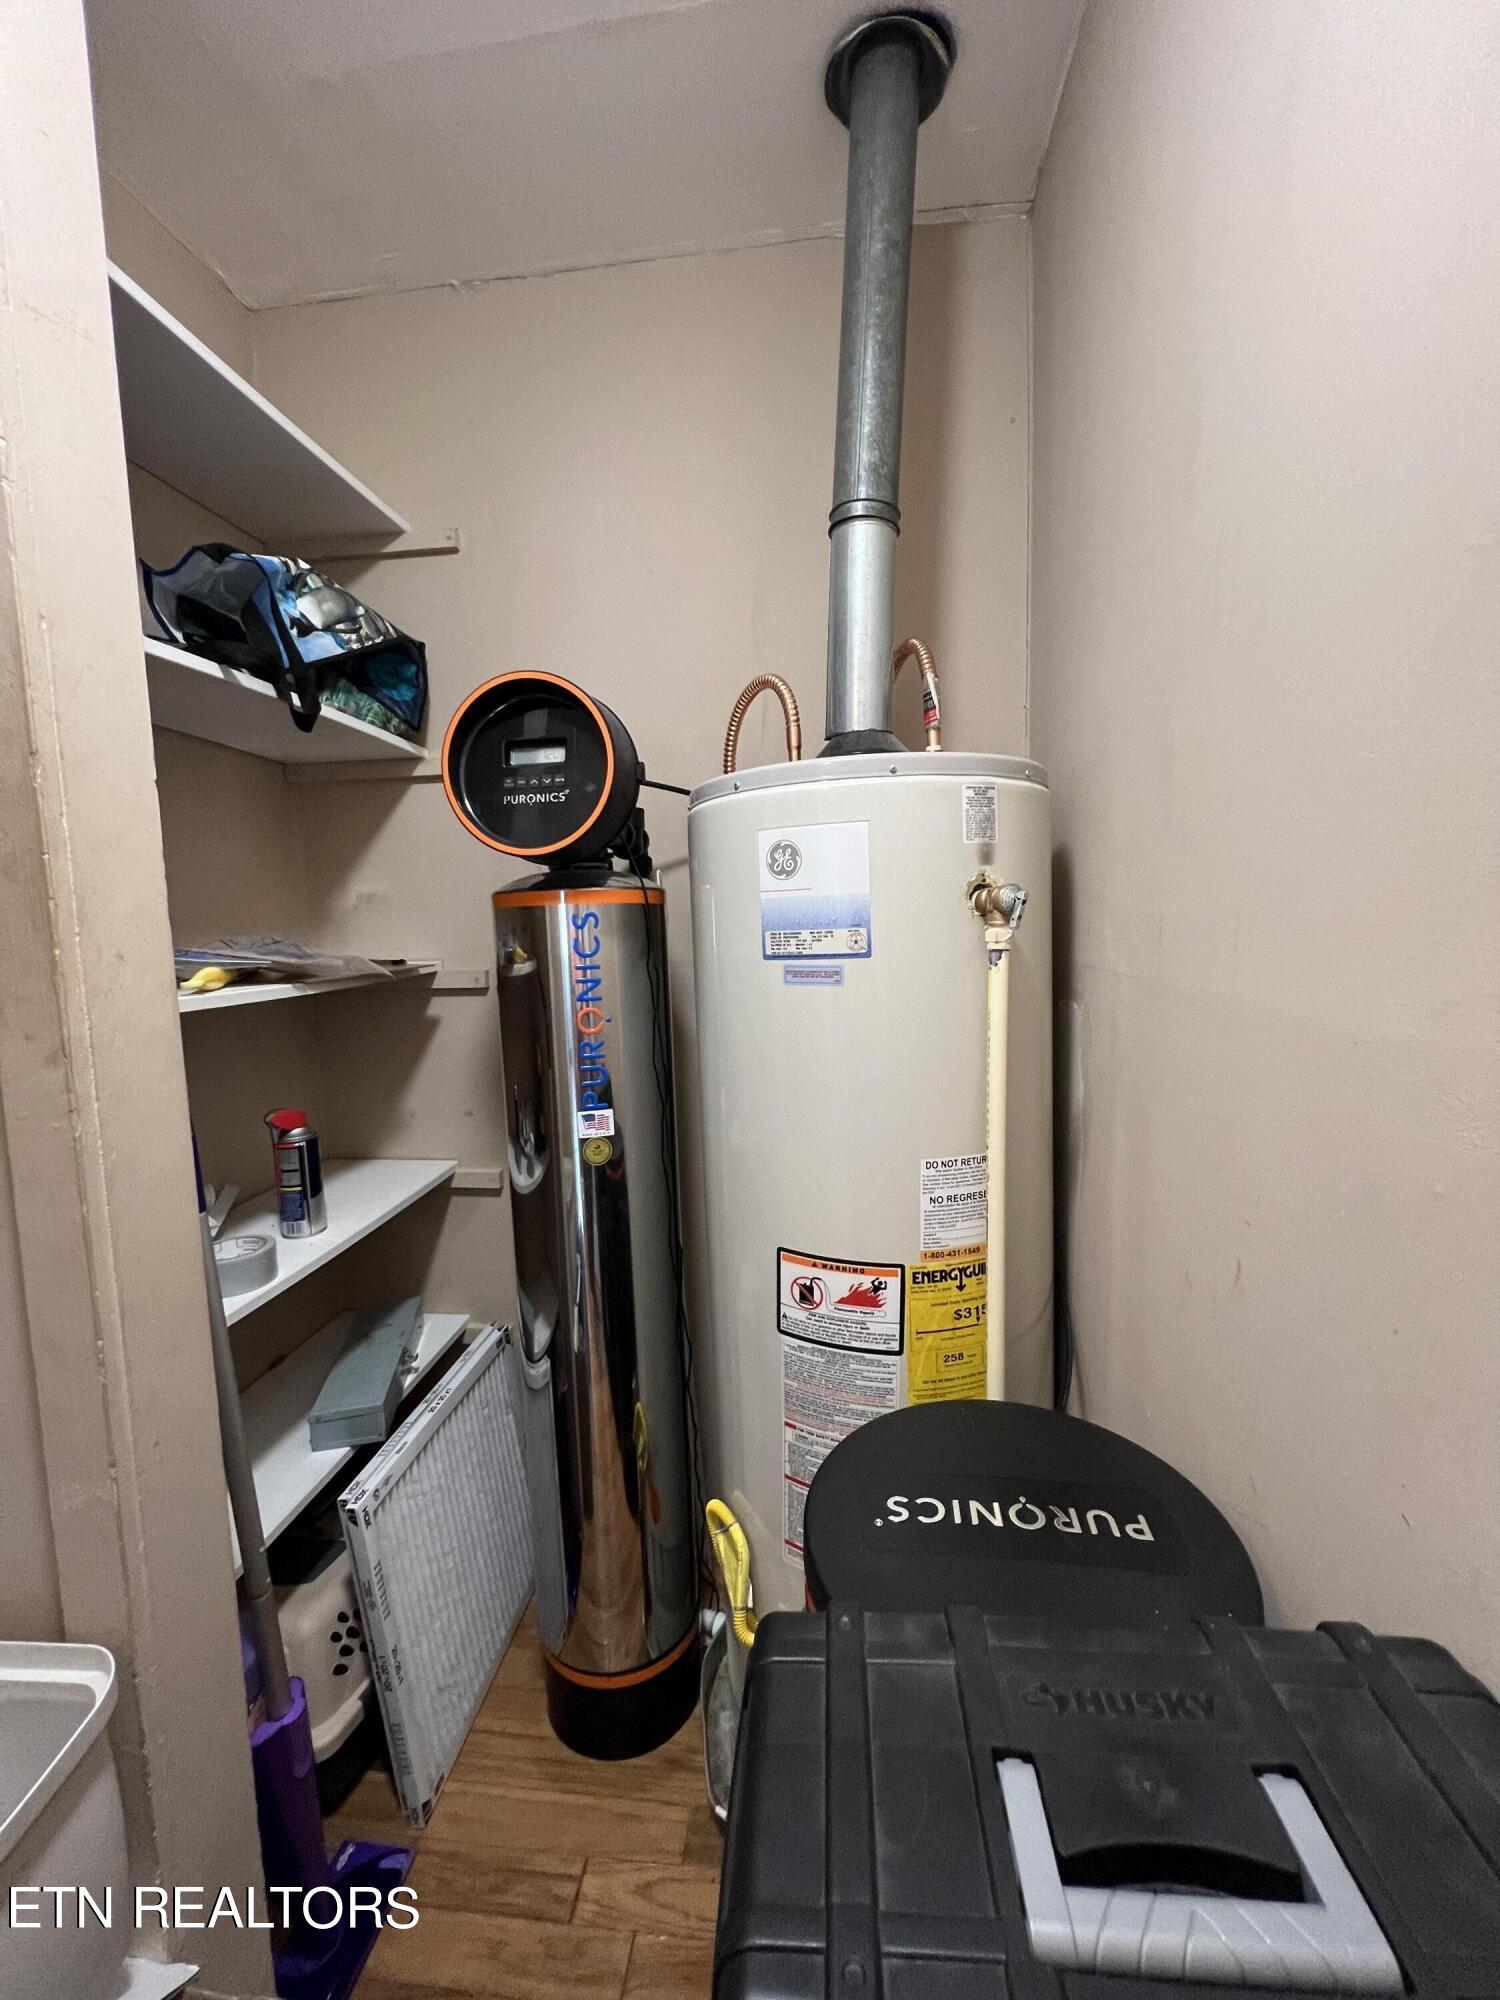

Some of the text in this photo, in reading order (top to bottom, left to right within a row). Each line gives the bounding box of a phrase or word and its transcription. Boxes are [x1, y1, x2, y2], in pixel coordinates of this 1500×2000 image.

[503, 791, 566, 806] PURONICS
[571, 911, 611, 1111] PURONICS
[925, 1161, 939, 1170] DO
[941, 1159, 958, 1169] NOT
[929, 1195, 944, 1205] NO
[923, 1246, 980, 1259] 1-800-431-1549
[822, 1261, 865, 1275] WARNING
[911, 1262, 987, 1286] ENERGYGUI
[943, 1352, 964, 1363] 258
[886, 1495, 1155, 1542] PURONICS
[1069, 1686, 1217, 1722] HUSKY
